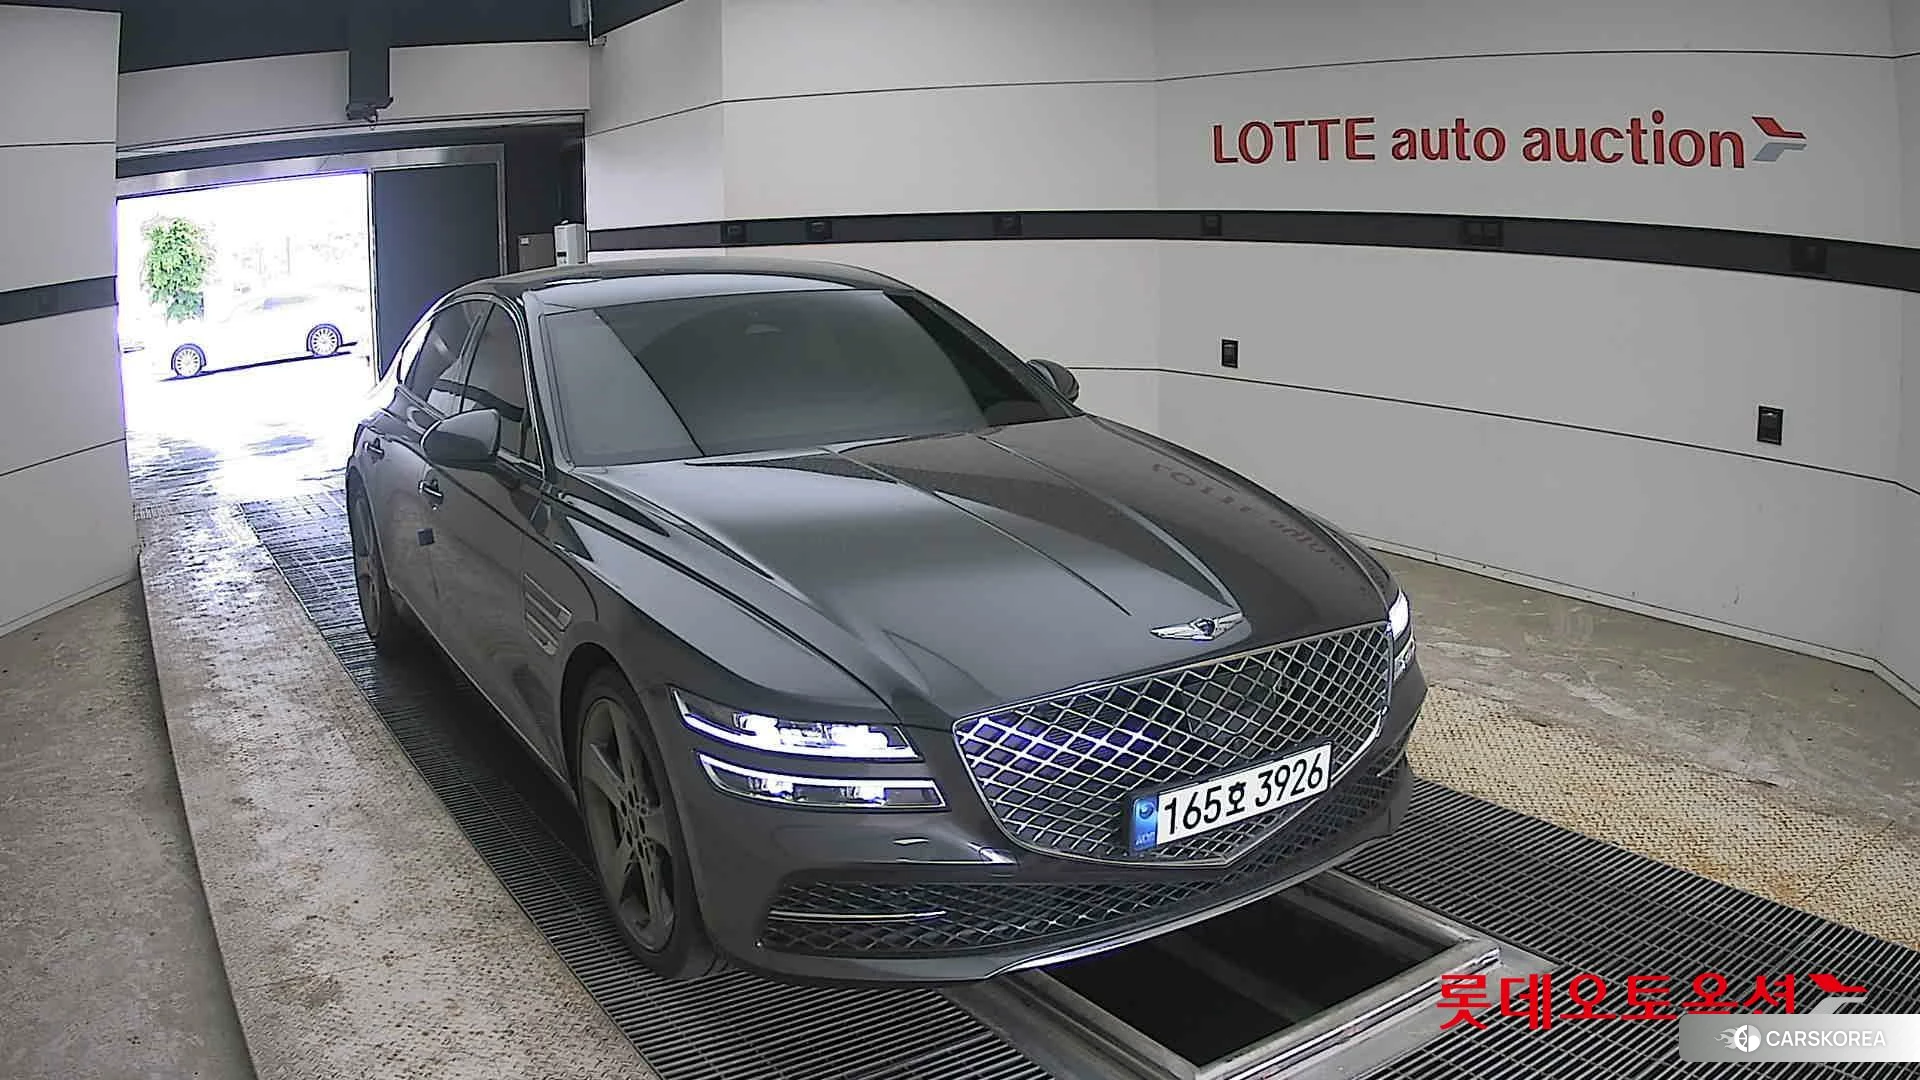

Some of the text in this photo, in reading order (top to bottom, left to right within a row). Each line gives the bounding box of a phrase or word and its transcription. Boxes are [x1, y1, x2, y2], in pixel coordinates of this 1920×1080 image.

[1213, 109, 1745, 168] LOTTE auto auction
[1255, 752, 1324, 807] 3926
